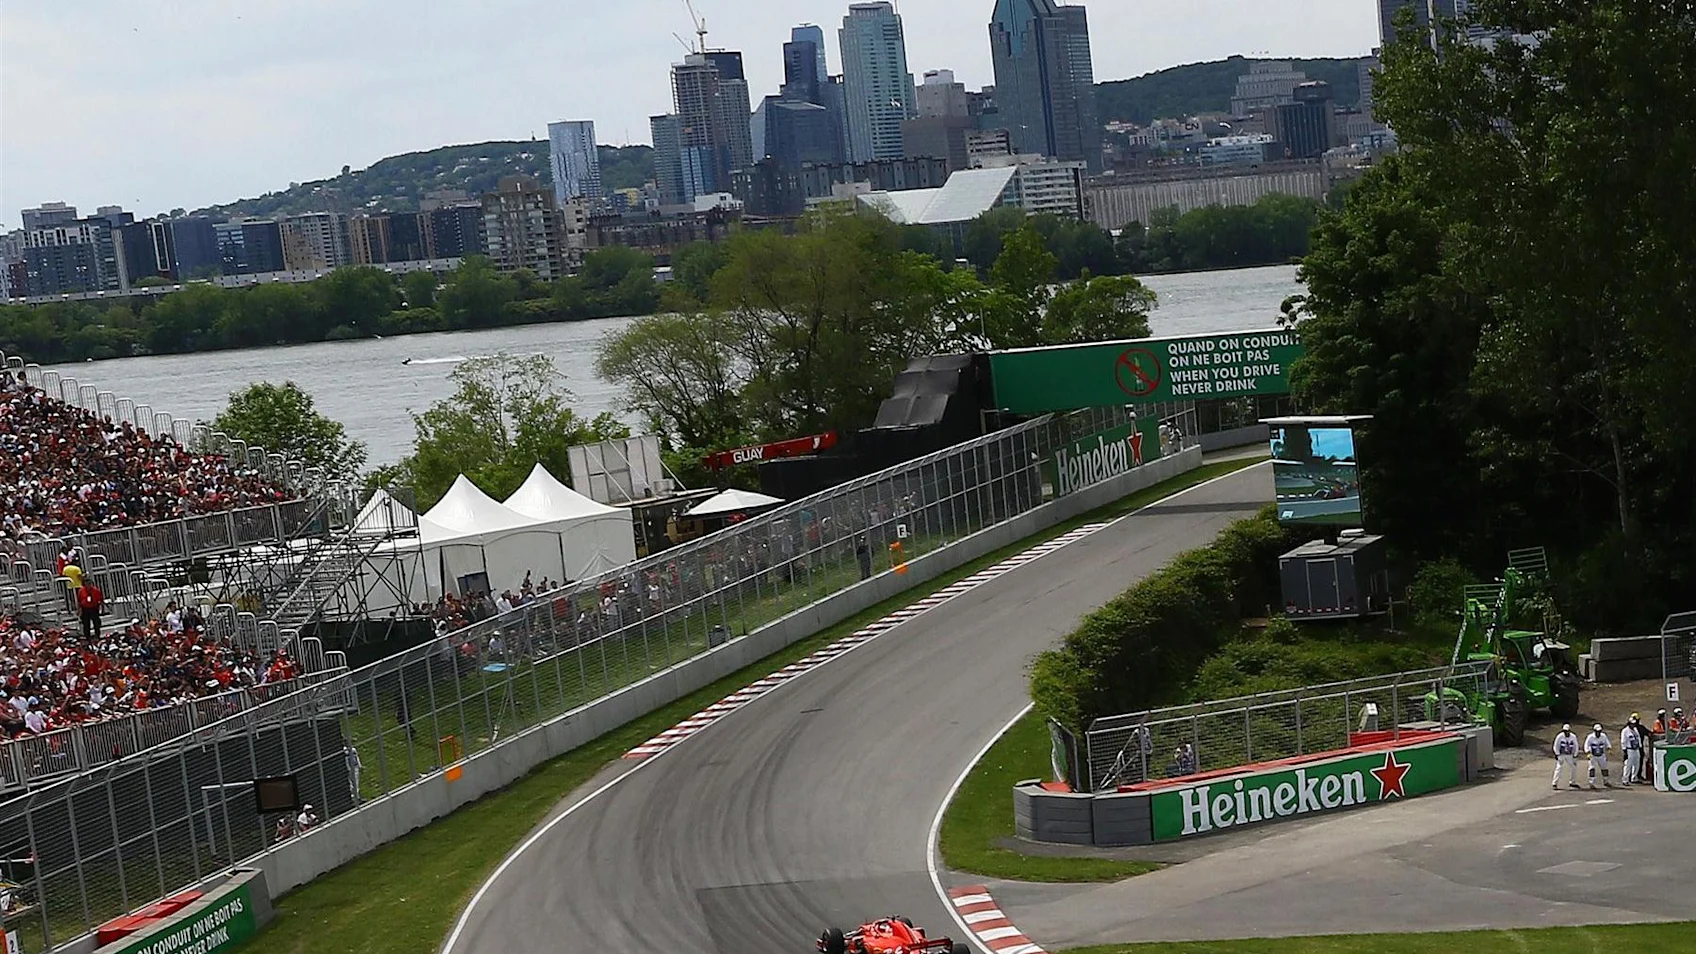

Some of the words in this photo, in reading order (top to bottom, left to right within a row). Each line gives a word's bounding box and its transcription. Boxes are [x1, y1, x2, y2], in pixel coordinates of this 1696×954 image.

[1168, 339, 1215, 354] QUAND
[1219, 338, 1239, 350] ON
[1169, 355, 1190, 367] ON
[1193, 354, 1210, 365] NE
[1214, 352, 1242, 364] BOIT
[1247, 350, 1270, 361] PAS
[1170, 370, 1208, 382] WHEN
[1212, 367, 1238, 379] YOU
[1243, 364, 1280, 377] DRIVE
[1172, 382, 1212, 395] NEVER
[1215, 379, 1257, 392] DRINK
[733, 447, 764, 463] GUAY
[1055, 435, 1129, 497] Heineken
[1669, 686, 1676, 698] F
[1179, 769, 1367, 836] Heineken
[193, 918, 205, 939] ON
[204, 913, 215, 930] NE
[214, 902, 232, 924] BOIT
[230, 898, 244, 917] PAS
[206, 926, 230, 951] DRINK
